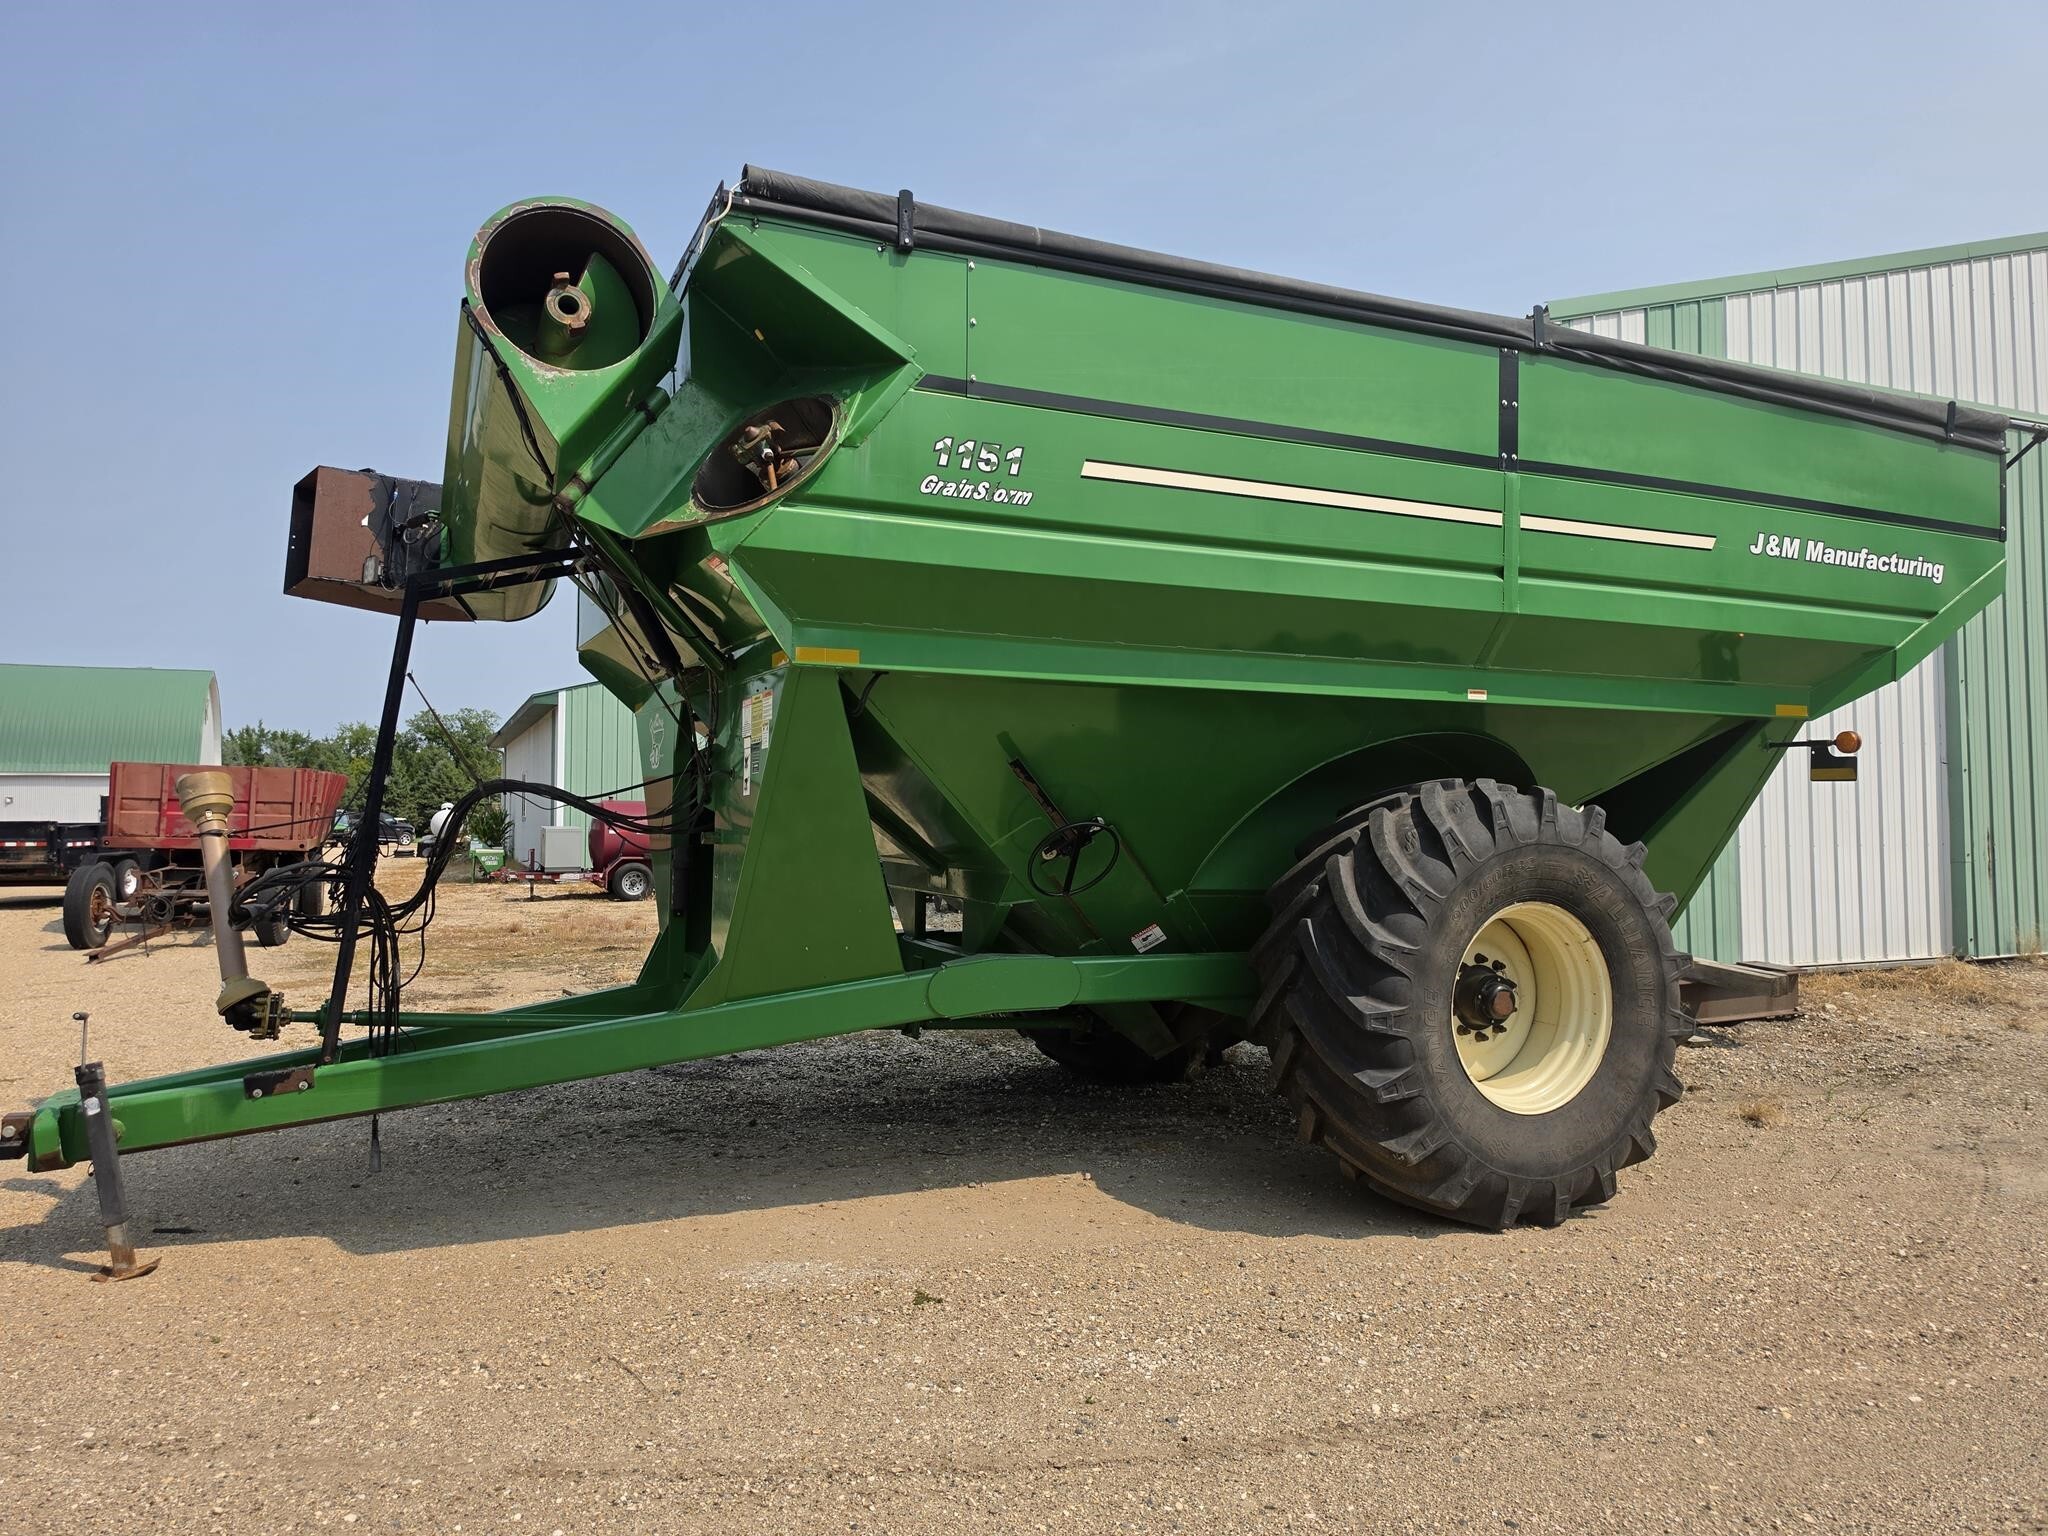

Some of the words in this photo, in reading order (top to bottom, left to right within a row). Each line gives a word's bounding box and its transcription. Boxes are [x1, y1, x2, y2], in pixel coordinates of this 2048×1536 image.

[933, 436, 1024, 476] 1151
[920, 474, 1034, 506] GrainSorm
[1749, 531, 1800, 560] J&M
[1805, 538, 1945, 584] Manufacturing
[1584, 882, 1657, 1030] ALLIANCE
